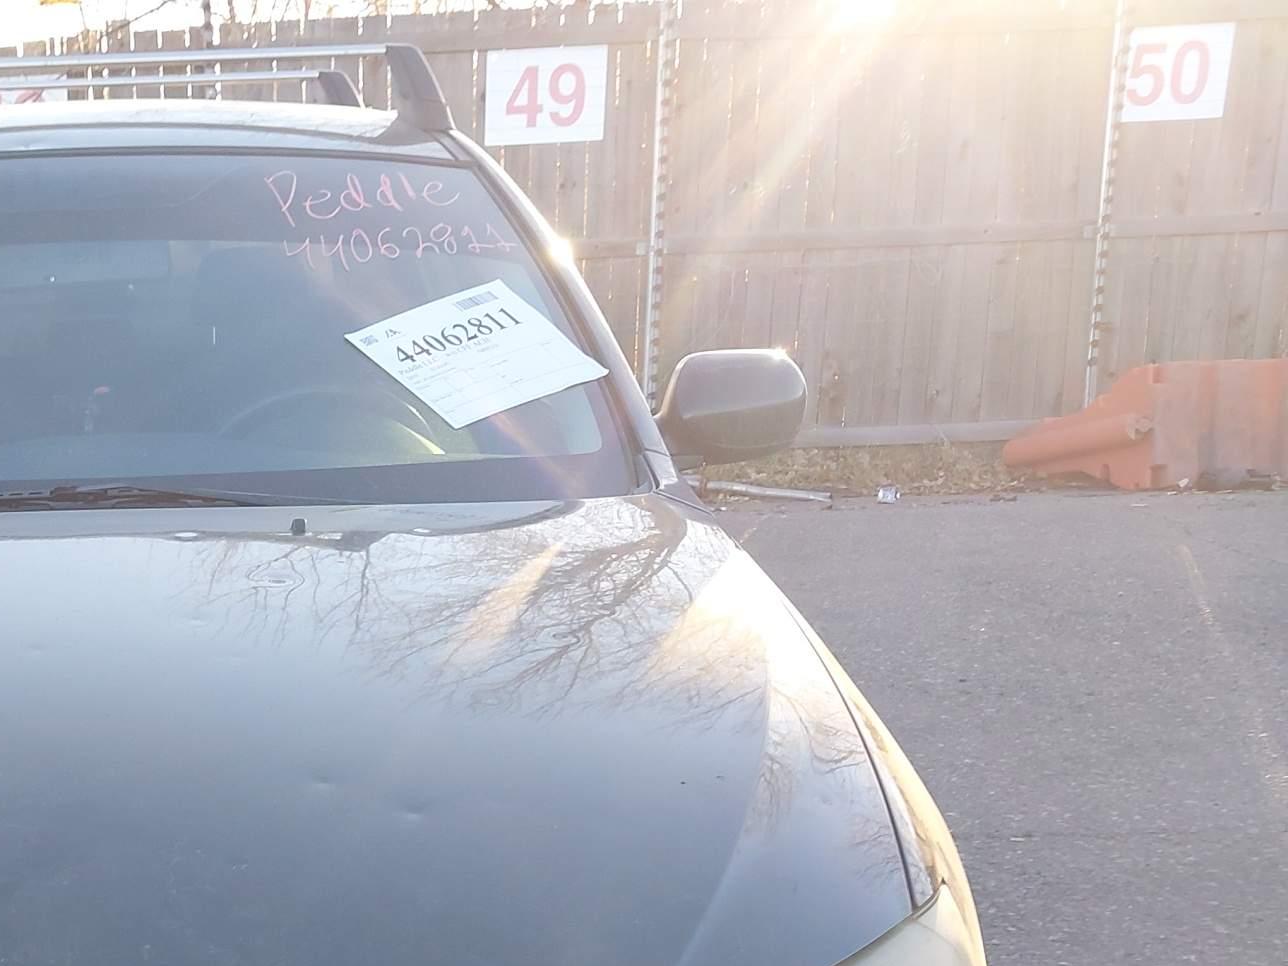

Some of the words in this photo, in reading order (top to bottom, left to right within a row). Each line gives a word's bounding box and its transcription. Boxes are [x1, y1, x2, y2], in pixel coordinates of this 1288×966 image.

[505, 62, 587, 128] 49
[1126, 41, 1211, 106] 50
[264, 170, 460, 227] Peddle
[396, 307, 523, 363] 44062811
